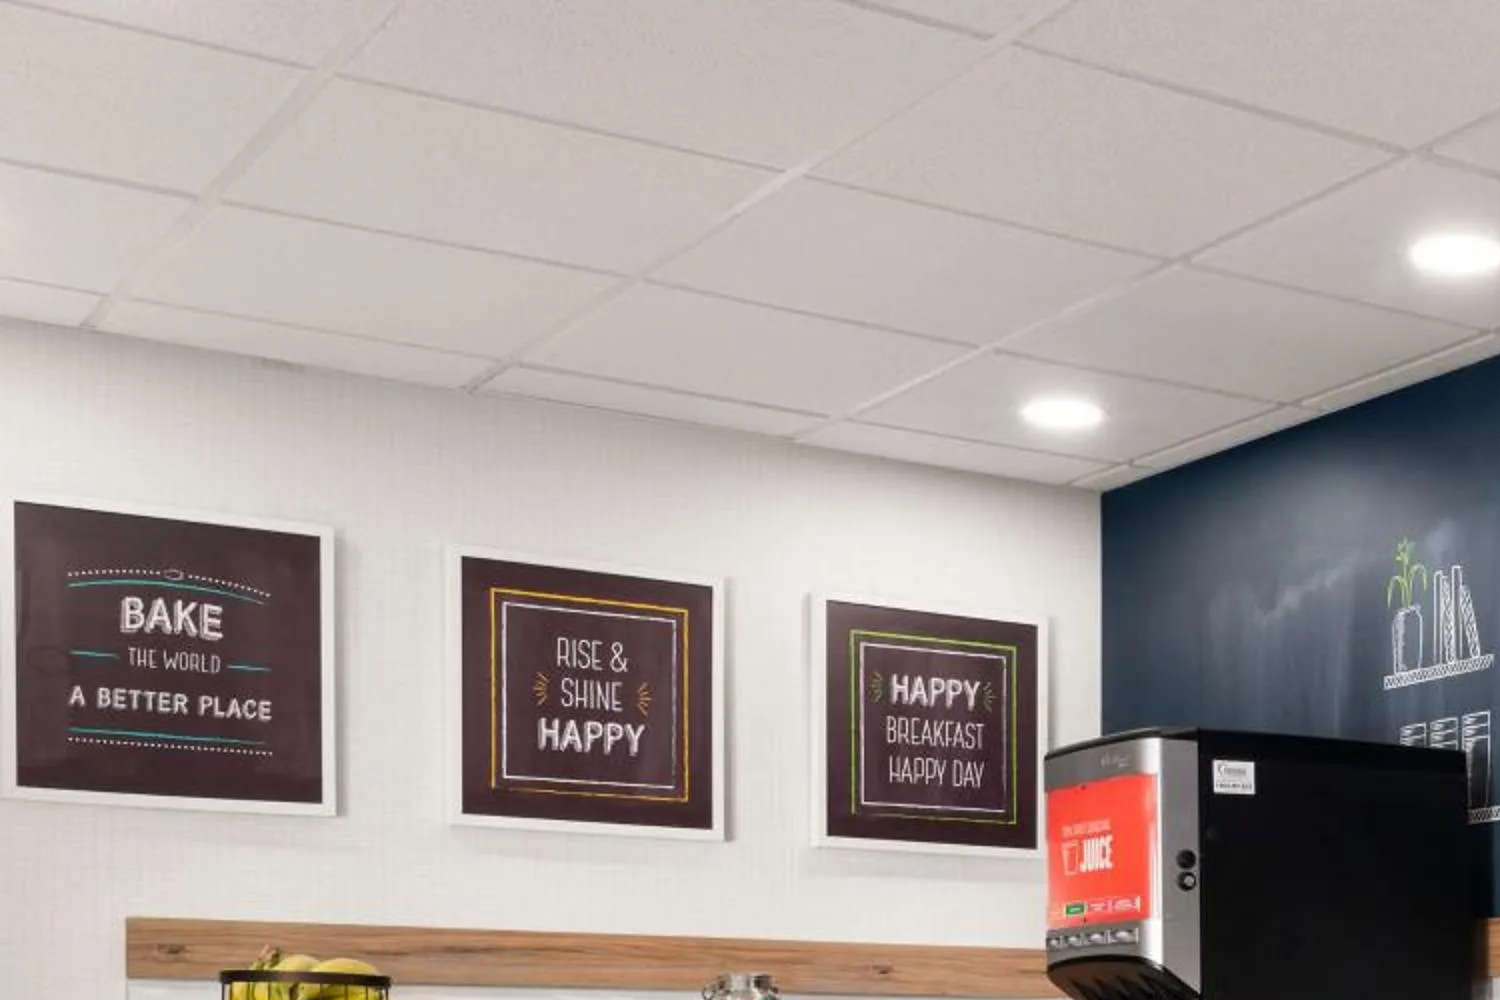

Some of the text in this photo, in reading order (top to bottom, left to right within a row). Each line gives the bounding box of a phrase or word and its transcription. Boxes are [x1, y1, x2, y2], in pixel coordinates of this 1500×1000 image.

[120, 597, 224, 641] BAKE
[128, 648, 221, 674] THE WORLD
[557, 637, 628, 672] RISE &
[68, 685, 273, 721] A BETTER PLACE
[560, 677, 623, 712] SHINE
[891, 673, 981, 711] HAPPY
[537, 717, 646, 756] HAPPY
[886, 715, 985, 750] BREAKFAST
[889, 756, 985, 789] HAPPY DAY
[1080, 834, 1113, 873] JUICE
